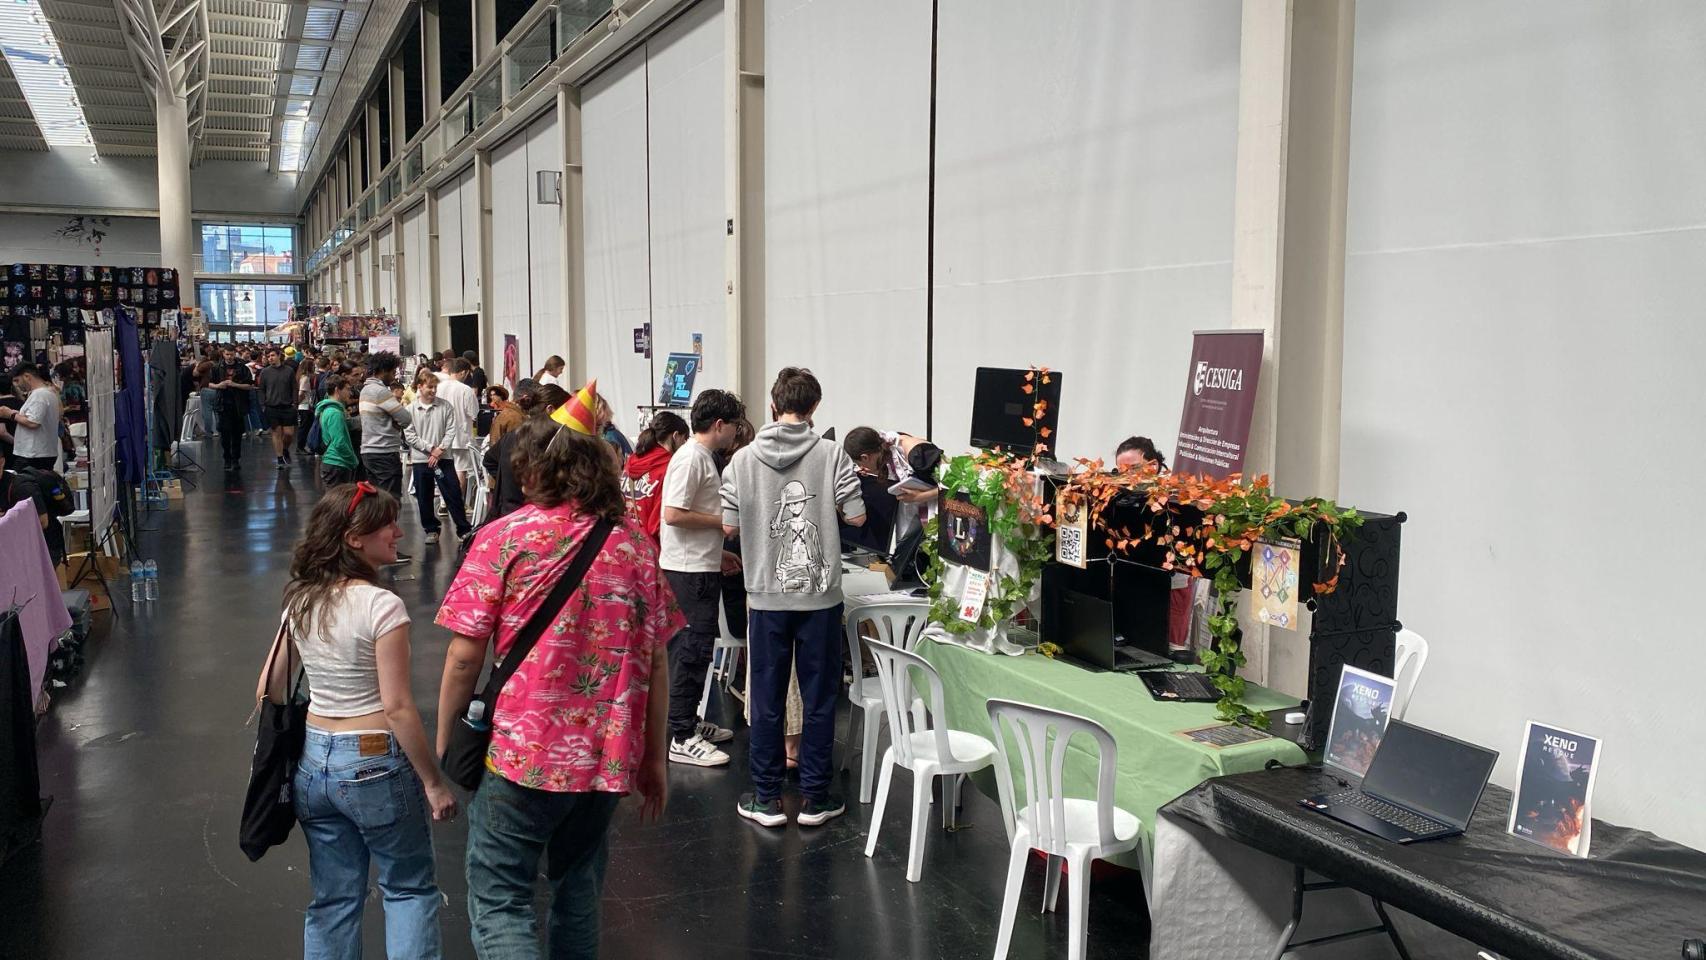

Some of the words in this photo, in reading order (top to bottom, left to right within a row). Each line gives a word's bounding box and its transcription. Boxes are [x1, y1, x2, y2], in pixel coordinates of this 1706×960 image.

[1206, 367, 1243, 391] CESUGA
[1352, 682, 1379, 700] XENO
[1543, 733, 1578, 752] XENO
